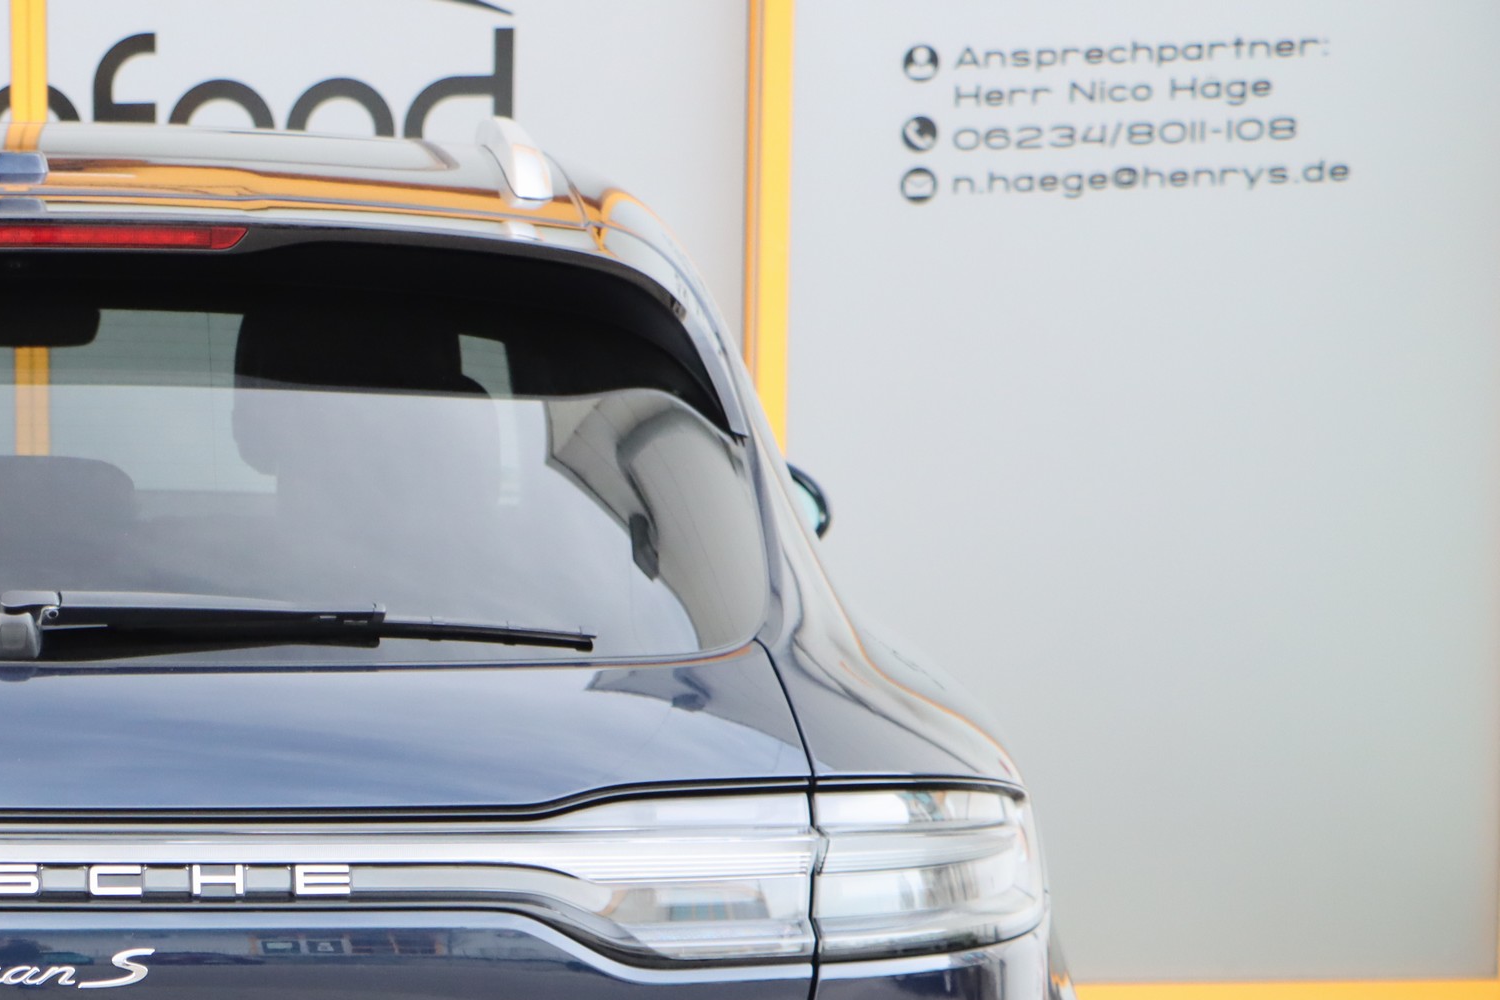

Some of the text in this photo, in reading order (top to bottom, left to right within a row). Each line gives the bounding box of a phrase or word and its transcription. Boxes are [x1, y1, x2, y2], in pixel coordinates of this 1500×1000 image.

[954, 36, 1330, 71] Ansprechpartner:
[953, 84, 1052, 107] Herr
[1068, 80, 1153, 104] Nico
[952, 116, 1299, 151] 06234/8011-108
[952, 159, 1352, 199] n.haege@henrys.de
[77, 947, 156, 989] S
